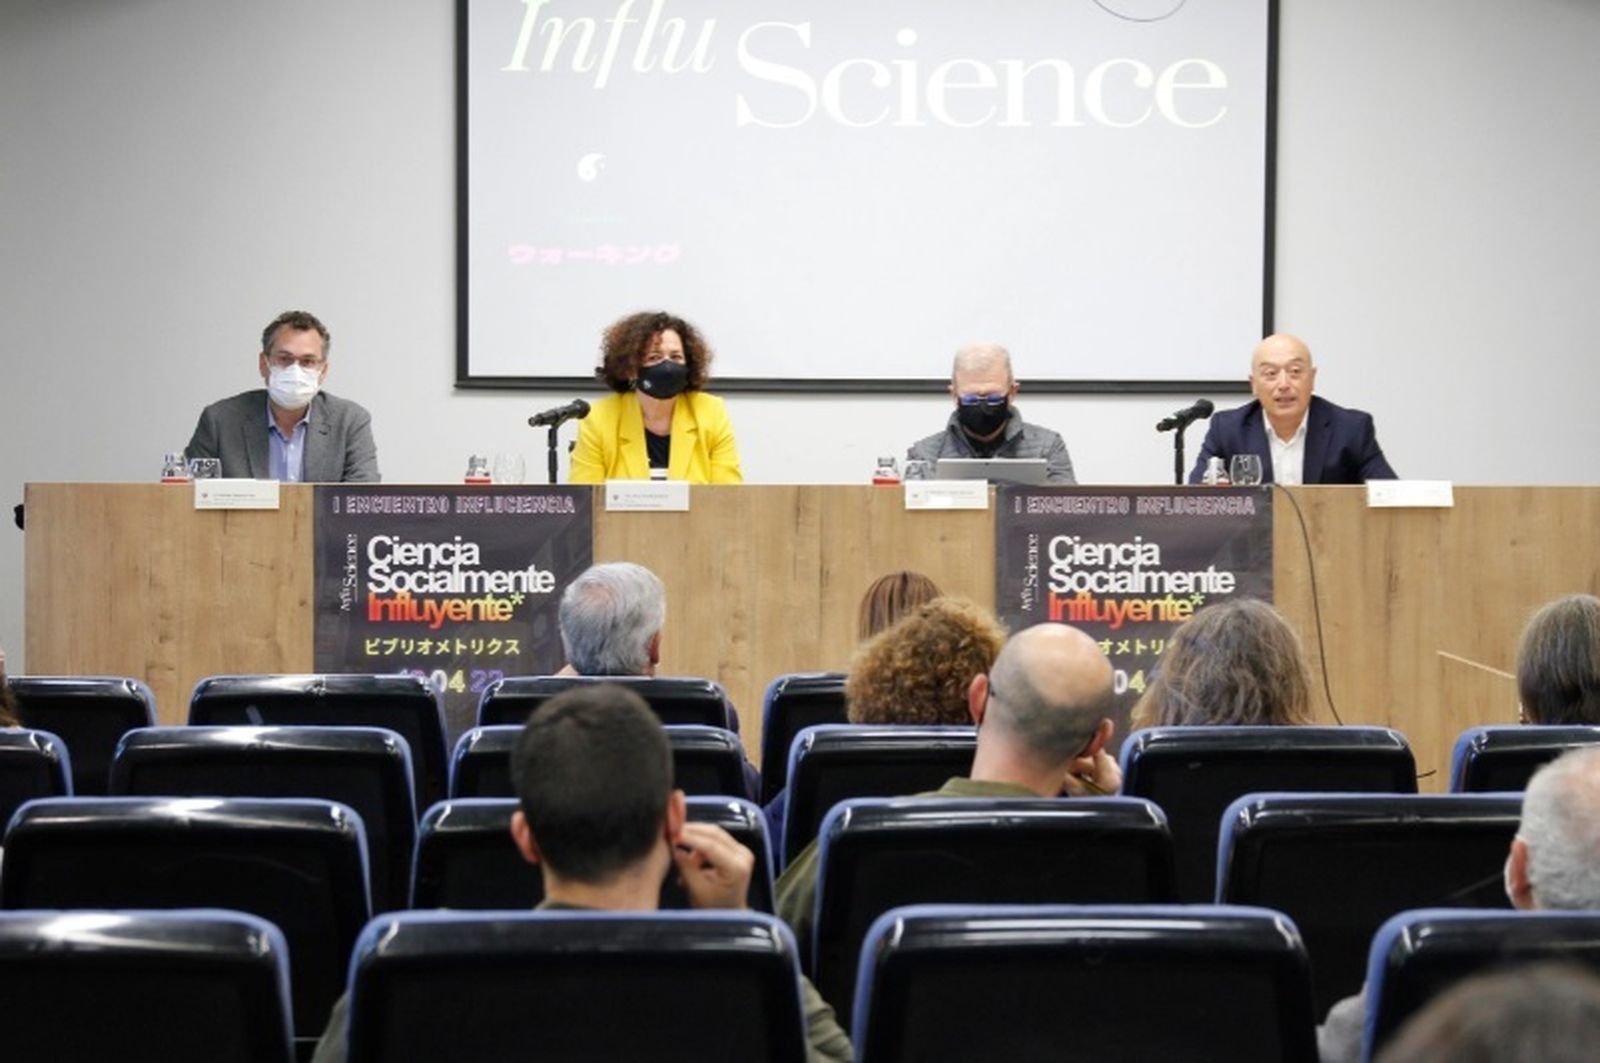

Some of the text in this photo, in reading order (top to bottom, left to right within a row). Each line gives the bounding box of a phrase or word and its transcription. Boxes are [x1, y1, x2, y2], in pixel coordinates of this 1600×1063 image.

[501, 0, 1229, 130] Influ Science
[333, 496, 576, 515] I ENCUENTRO INFLUCIENCIA
[1015, 496, 1256, 516] I ENCUENTRO INFLUCIENCIA
[367, 535, 480, 568] Ciencia
[1049, 535, 1161, 568] Ciencia
[367, 564, 556, 593] Socialmente
[1049, 564, 1236, 593] Socialmente
[365, 638, 521, 656] ビブリオメトリクス
